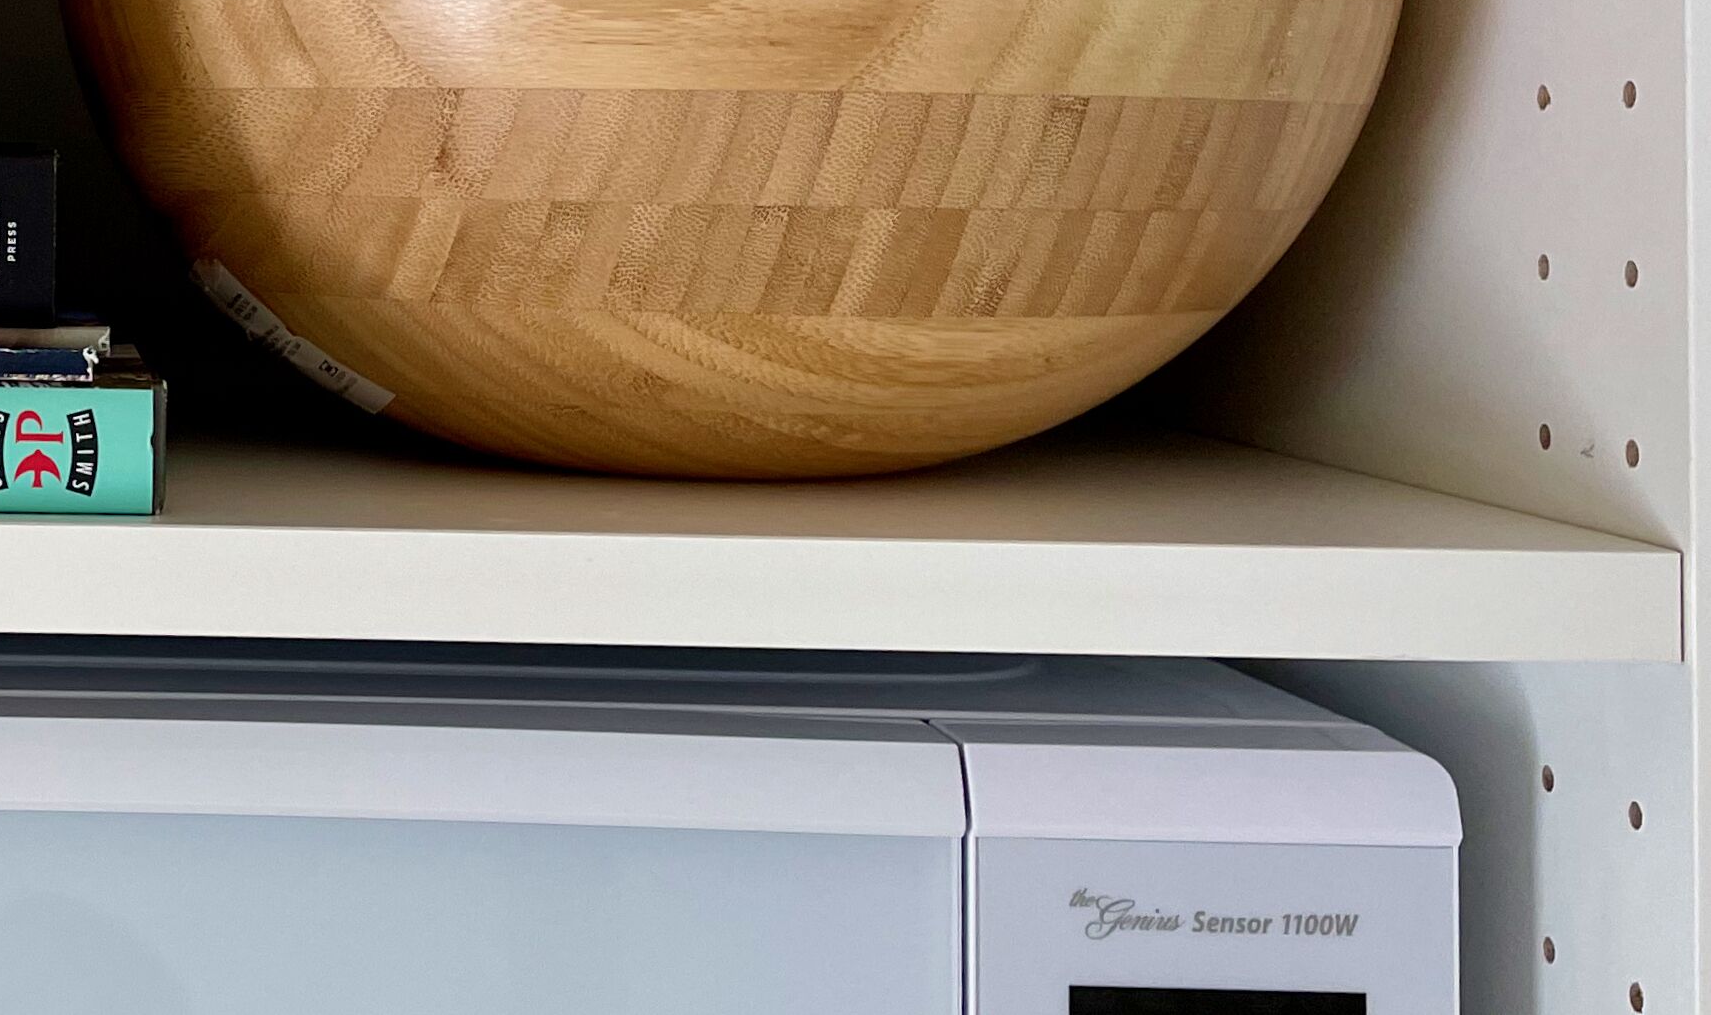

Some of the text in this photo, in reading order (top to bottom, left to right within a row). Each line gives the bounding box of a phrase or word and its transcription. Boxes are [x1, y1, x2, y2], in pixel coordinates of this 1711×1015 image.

[6, 221, 18, 262] PRESS
[72, 412, 93, 491] SMITH
[1069, 887, 1359, 939] the Genius Sensor 1100W
